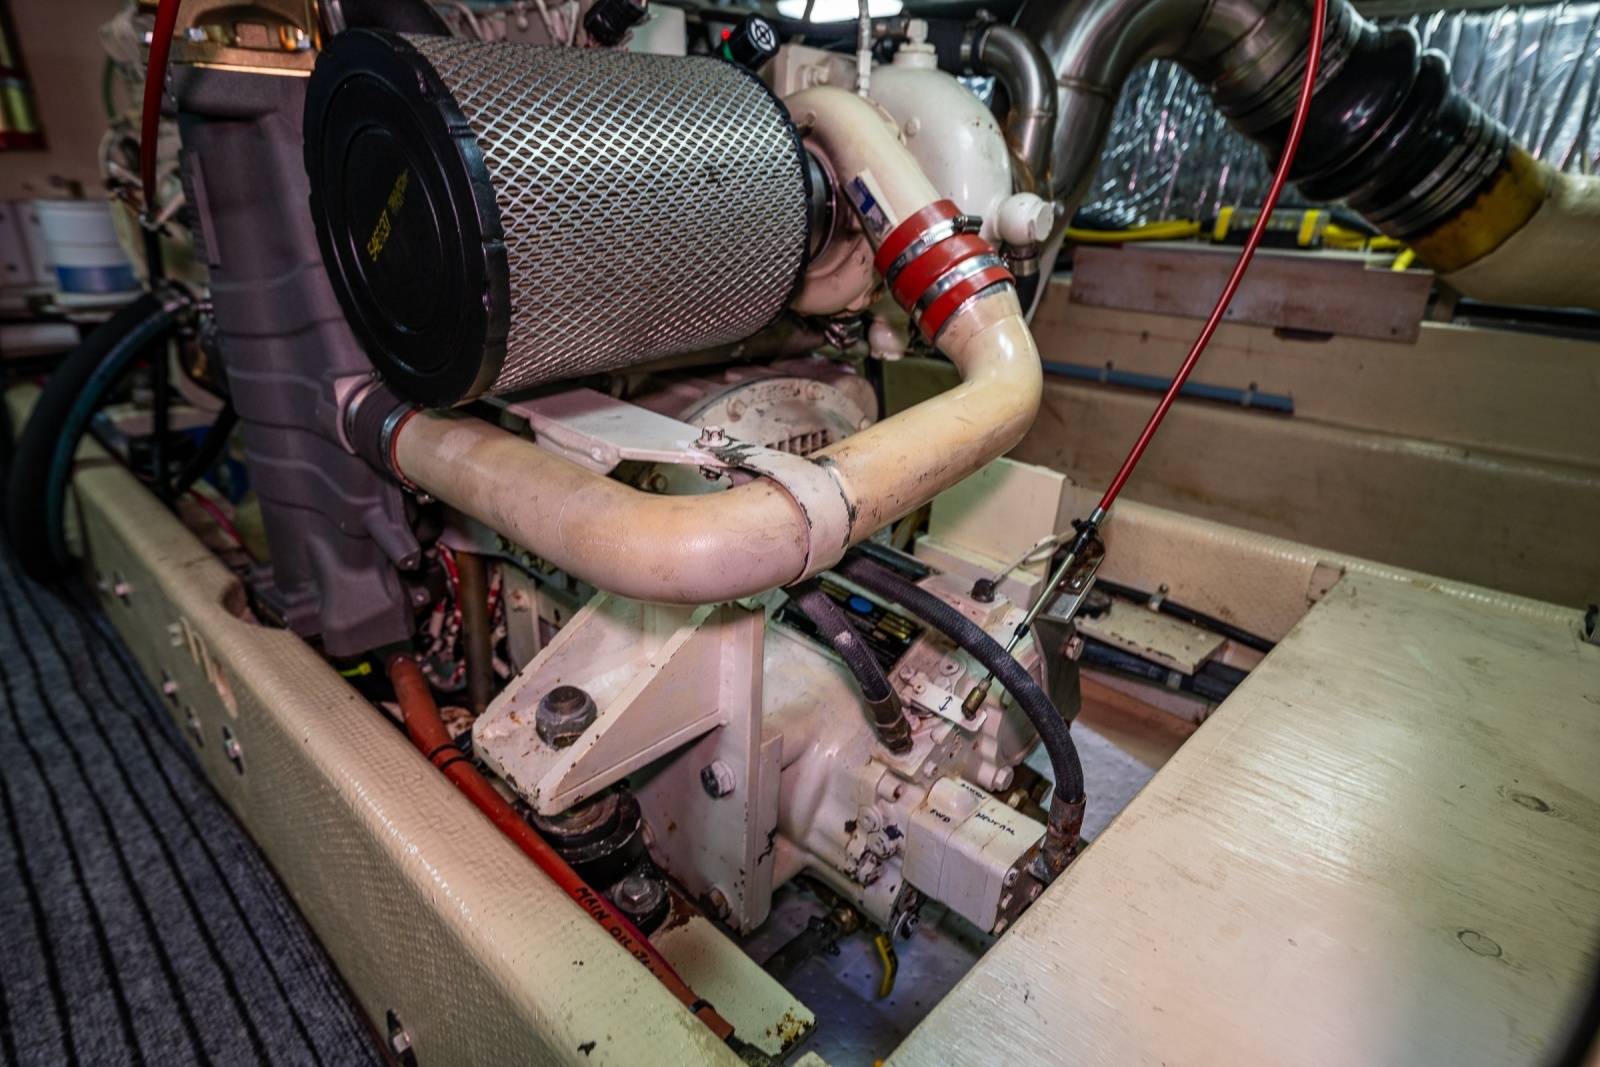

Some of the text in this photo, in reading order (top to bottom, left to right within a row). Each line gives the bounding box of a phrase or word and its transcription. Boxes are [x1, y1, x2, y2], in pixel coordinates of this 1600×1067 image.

[929, 808, 951, 823] FWD
[575, 887, 633, 947] MAIN OIL
